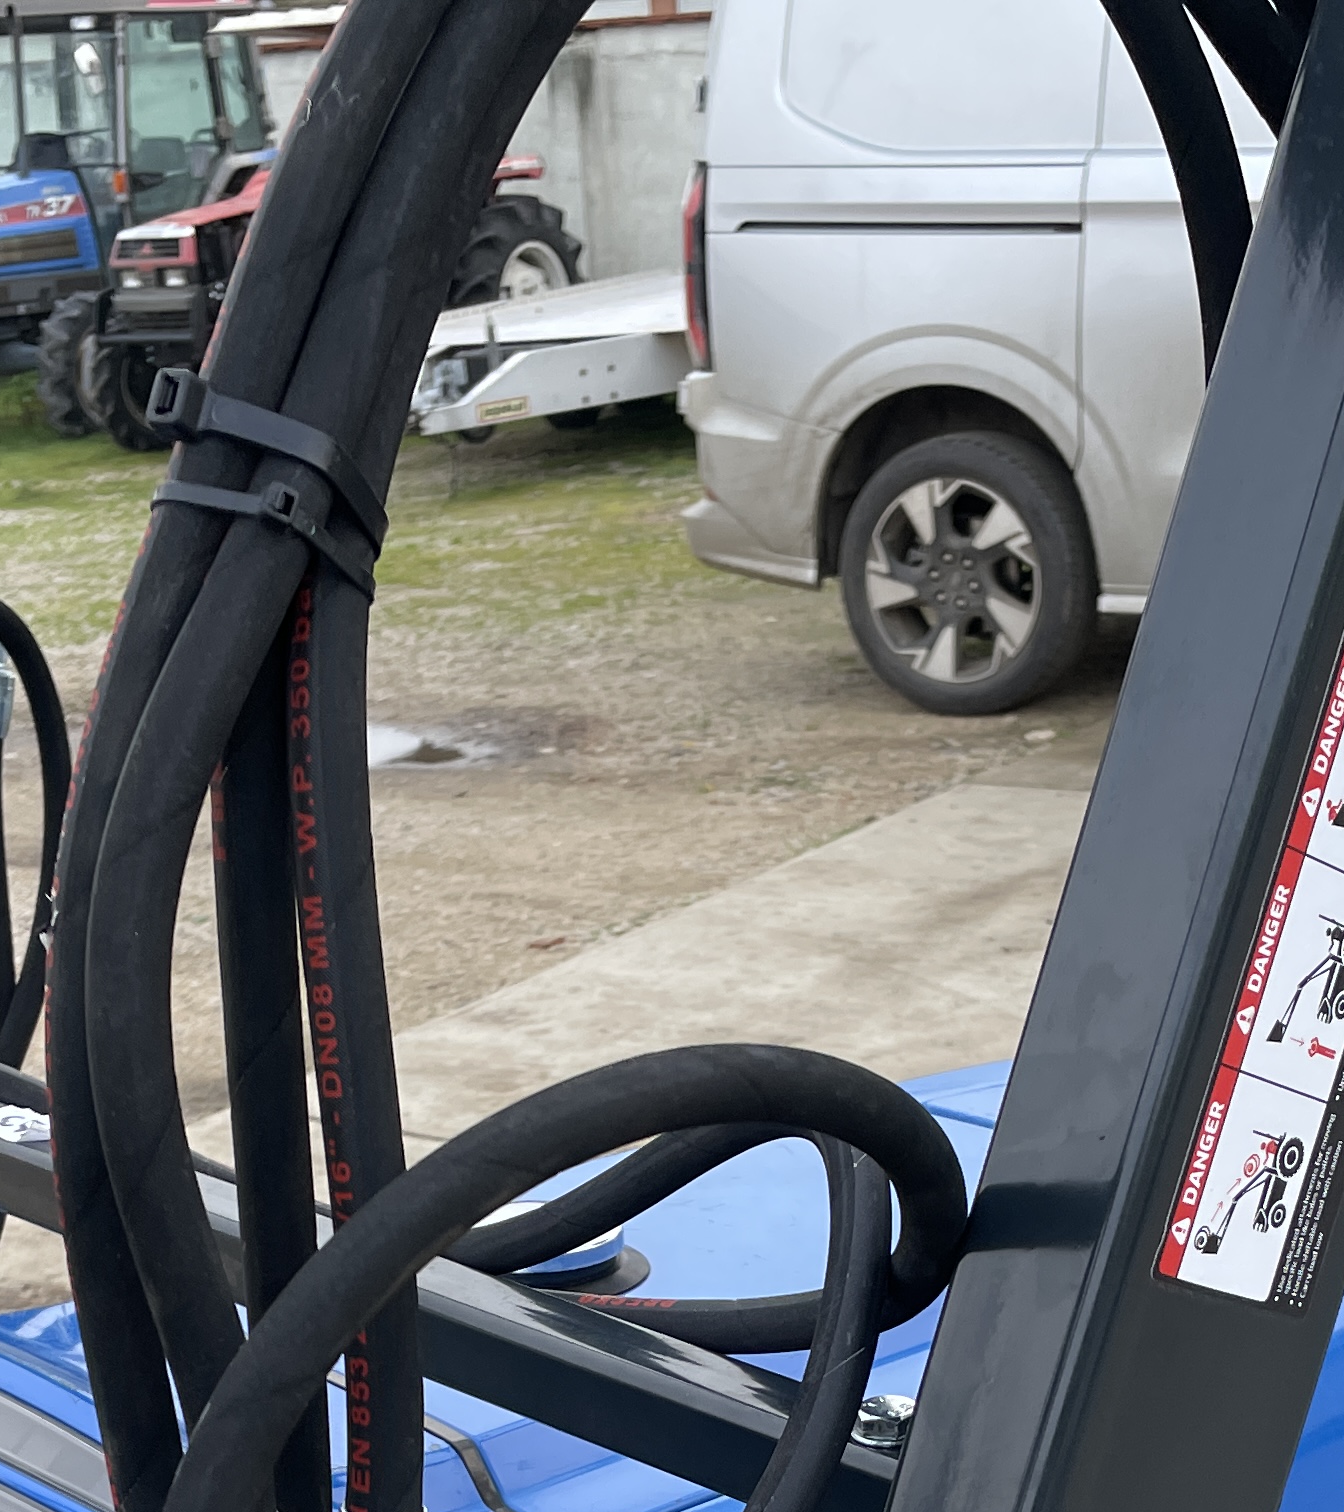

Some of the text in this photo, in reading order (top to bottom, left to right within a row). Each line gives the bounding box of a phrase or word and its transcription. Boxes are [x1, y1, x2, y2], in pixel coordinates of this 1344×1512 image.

[43, 194, 77, 217] 37
[290, 658, 311, 738] 350
[303, 896, 331, 970] MM
[1243, 883, 1293, 994] DANGER
[313, 983, 344, 1099] DN08
[1179, 1099, 1228, 1207] DANGER
[350, 1355, 371, 1428] 853
[351, 1437, 371, 1494] EN
